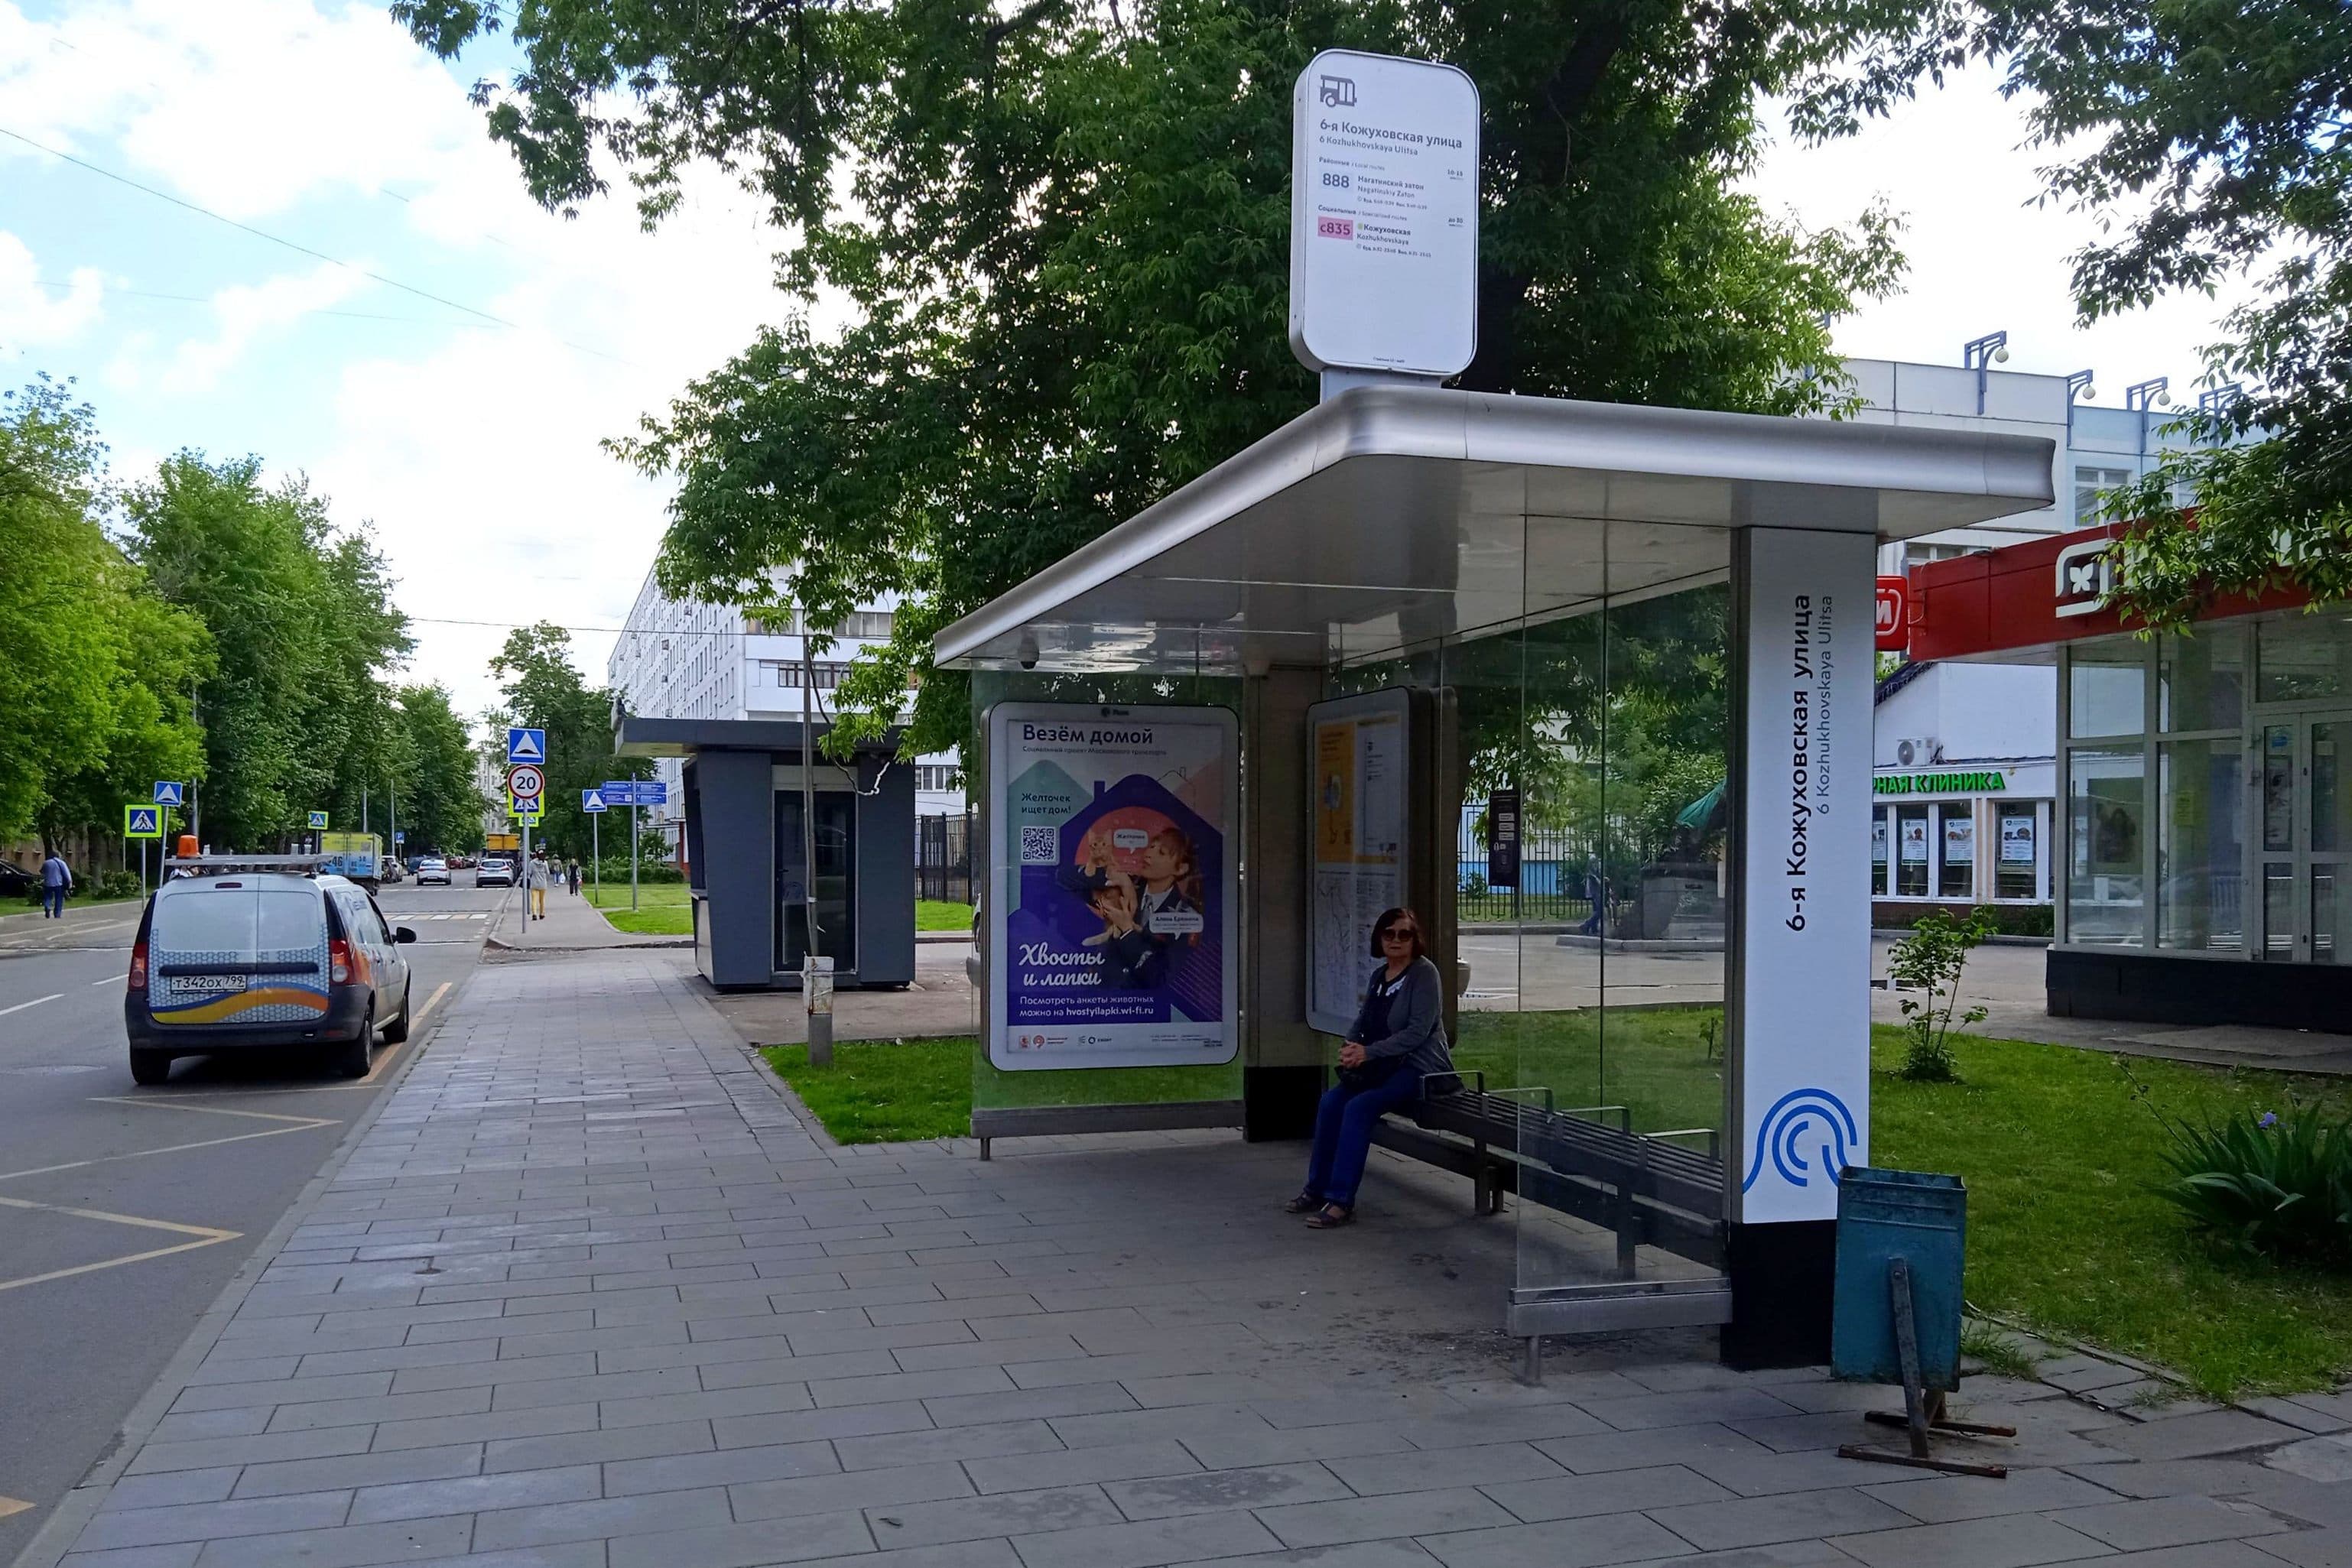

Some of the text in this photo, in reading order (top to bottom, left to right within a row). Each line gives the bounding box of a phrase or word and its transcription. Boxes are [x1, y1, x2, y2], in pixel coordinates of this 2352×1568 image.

[1320, 118, 1462, 149] 6-я Кожуховская улица
[1327, 136, 1393, 154] Kozhukhovskaya
[1395, 145, 1418, 155] Ulitsa
[1322, 173, 1350, 188] 888
[1357, 175, 1403, 188] Нагатинский
[1320, 222, 1351, 236] с835
[1363, 223, 1411, 235] Кожуховская
[1356, 233, 1409, 245] Kozhukhovskaya
[1816, 595, 1835, 814] 6 Kozhukhovskaya Ulitsa
[1023, 724, 1152, 745] Везём домой
[1785, 594, 1813, 932] 6-я Кожуховская улица
[516, 776, 536, 790] 20
[1915, 771, 2006, 793] КЛИНИКА
[1022, 792, 1071, 802] Желточек
[1022, 803, 1071, 815] ищет дом!
[1018, 941, 1106, 966] Хвосты
[225, 976, 244, 985] 799
[1023, 972, 1102, 986] и лапки
[1020, 996, 1075, 1005] Посмотреть
[1066, 1006, 1154, 1018] hvostyilapki.wi-fi.ru
